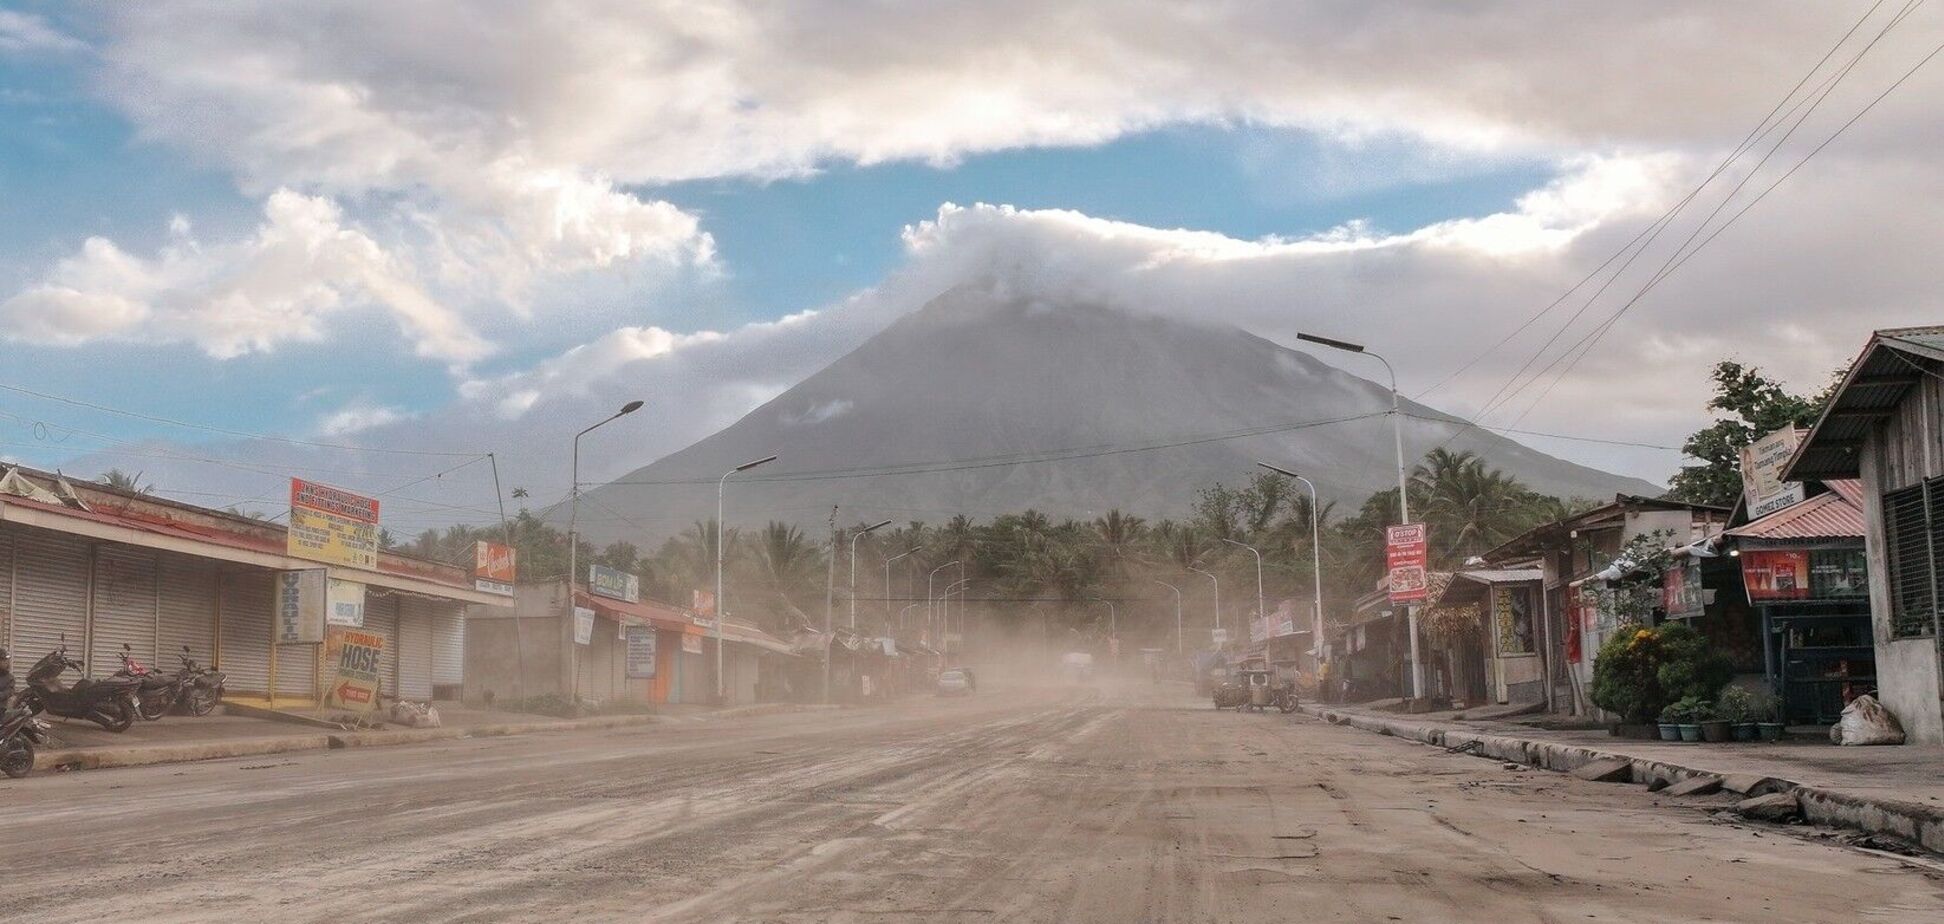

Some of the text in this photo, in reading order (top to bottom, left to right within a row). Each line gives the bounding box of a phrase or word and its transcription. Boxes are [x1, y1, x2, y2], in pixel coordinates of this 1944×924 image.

[297, 492, 311, 503] AND
[311, 495, 340, 512] FITTINGS
[340, 504, 376, 521] MARKETING
[1756, 501, 1775, 516] GOMEZ
[1775, 494, 1795, 509] STORE
[344, 630, 385, 649] HYDRAULIC
[340, 643, 381, 673] HOSE
